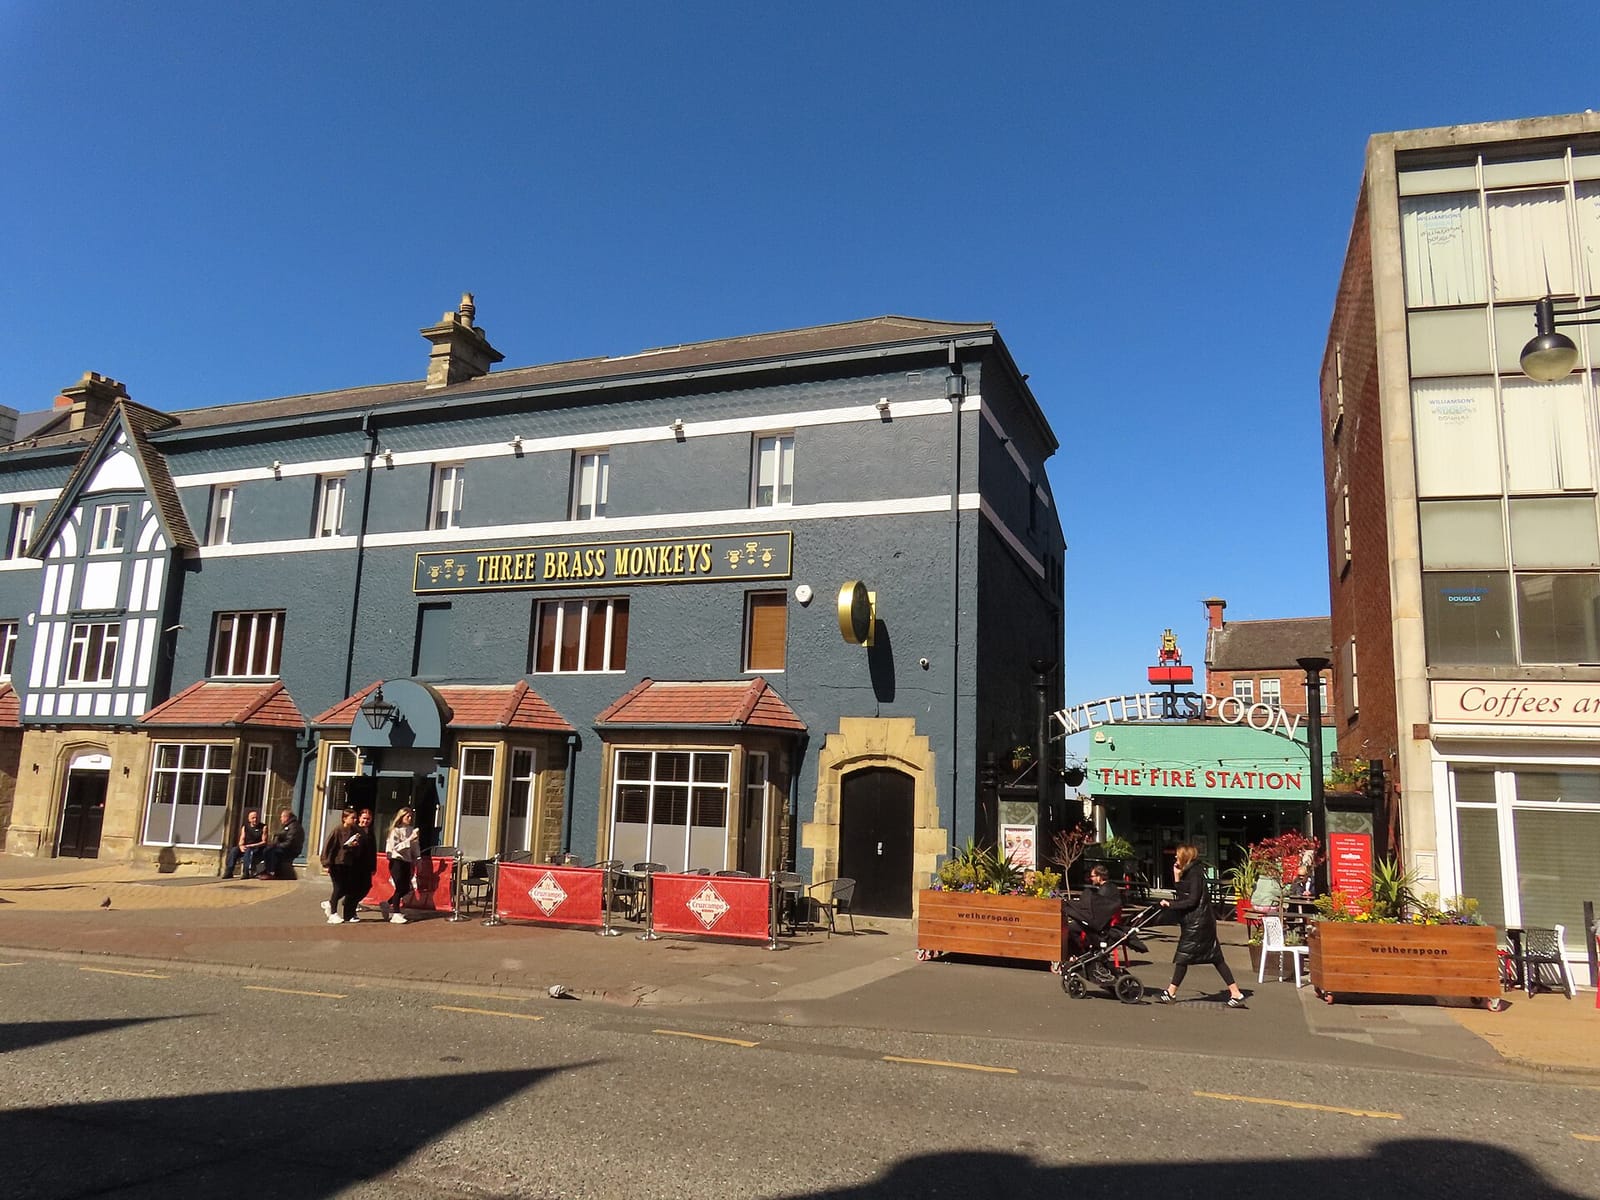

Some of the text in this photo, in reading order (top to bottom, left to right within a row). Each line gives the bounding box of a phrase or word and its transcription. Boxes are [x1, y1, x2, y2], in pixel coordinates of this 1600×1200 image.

[477, 543, 713, 583] THREE BRASS MONKEYS
[1460, 687, 1562, 717] Coffees
[1054, 692, 1301, 741] WETHERSPOON
[1100, 768, 1302, 790] THE FIRE STATION
[692, 901, 725, 910] Cruzcampo
[957, 911, 1020, 923] wetherspoon
[1371, 945, 1448, 956] wetherspoon
